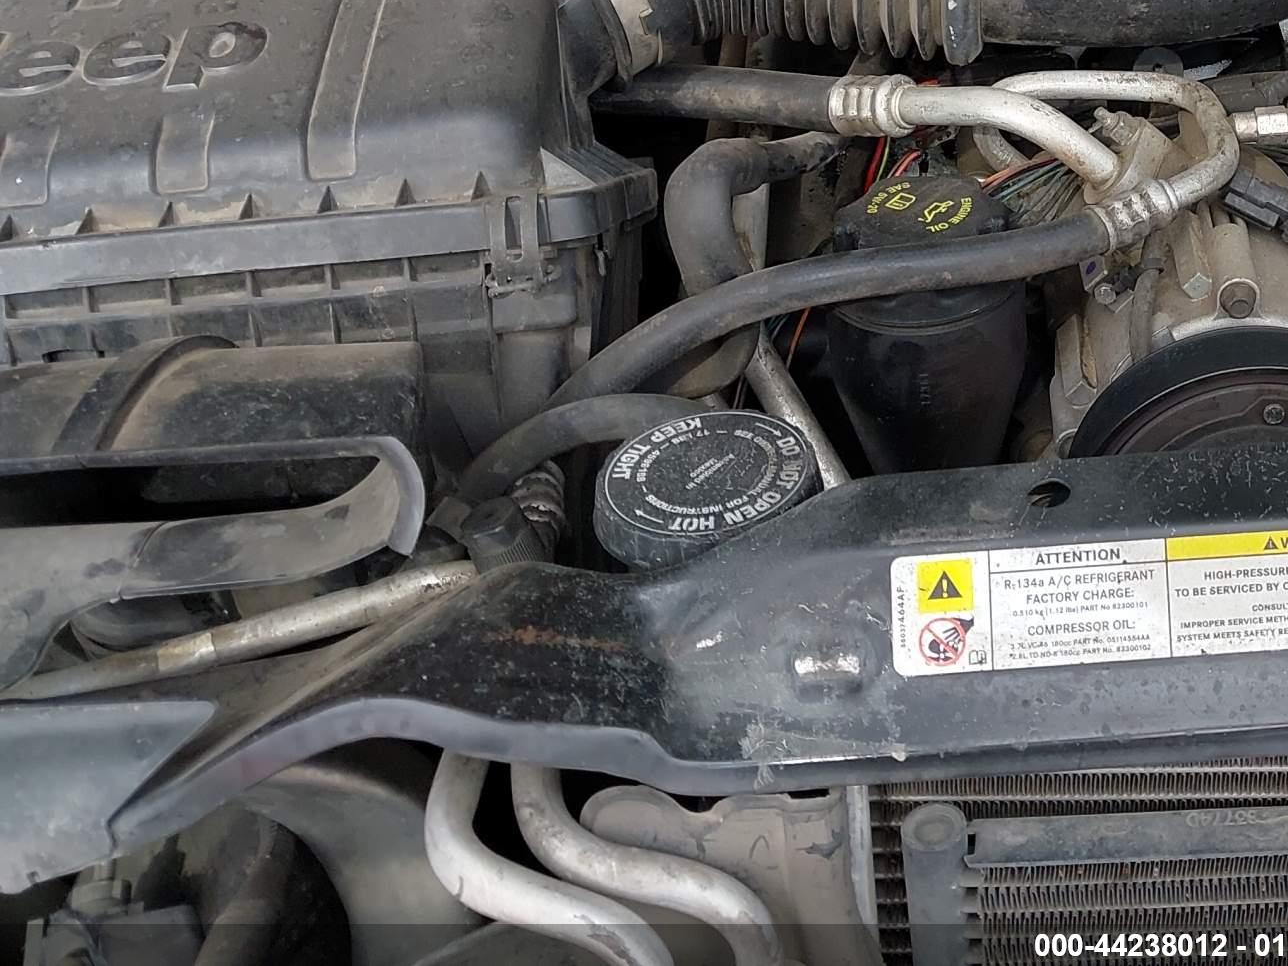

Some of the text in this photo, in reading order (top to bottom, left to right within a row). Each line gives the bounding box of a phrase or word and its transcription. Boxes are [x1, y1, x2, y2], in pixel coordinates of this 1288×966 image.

[0, 21, 268, 96] eep
[926, 197, 972, 233] ENGINE OIL
[612, 417, 702, 479] KEEP TIGHT
[667, 436, 802, 532] DO NOT OPEN HOT
[645, 494, 724, 515] INSTRUCTIONS
[725, 494, 750, 509] FOR
[1035, 548, 1120, 565] ATTENTION
[1047, 574, 1071, 586] A/C
[1074, 569, 1155, 585] REFRIGERANT
[1026, 587, 1134, 604] FACTORY CHARGE:
[1175, 587, 1189, 597] TO
[1192, 586, 1206, 596] BE
[1209, 583, 1263, 595] SERVICED
[1266, 582, 1280, 591] BY
[1080, 604, 1102, 612] PART
[1027, 619, 1135, 636] COMPRESSOR OIL:
[1180, 619, 1225, 629] IMPROPER
[1227, 616, 1263, 626] SERVICE
[1176, 632, 1210, 641] SYSTEM
[1213, 630, 1241, 639] MEETS
[1244, 628, 1275, 637] SAFETY
